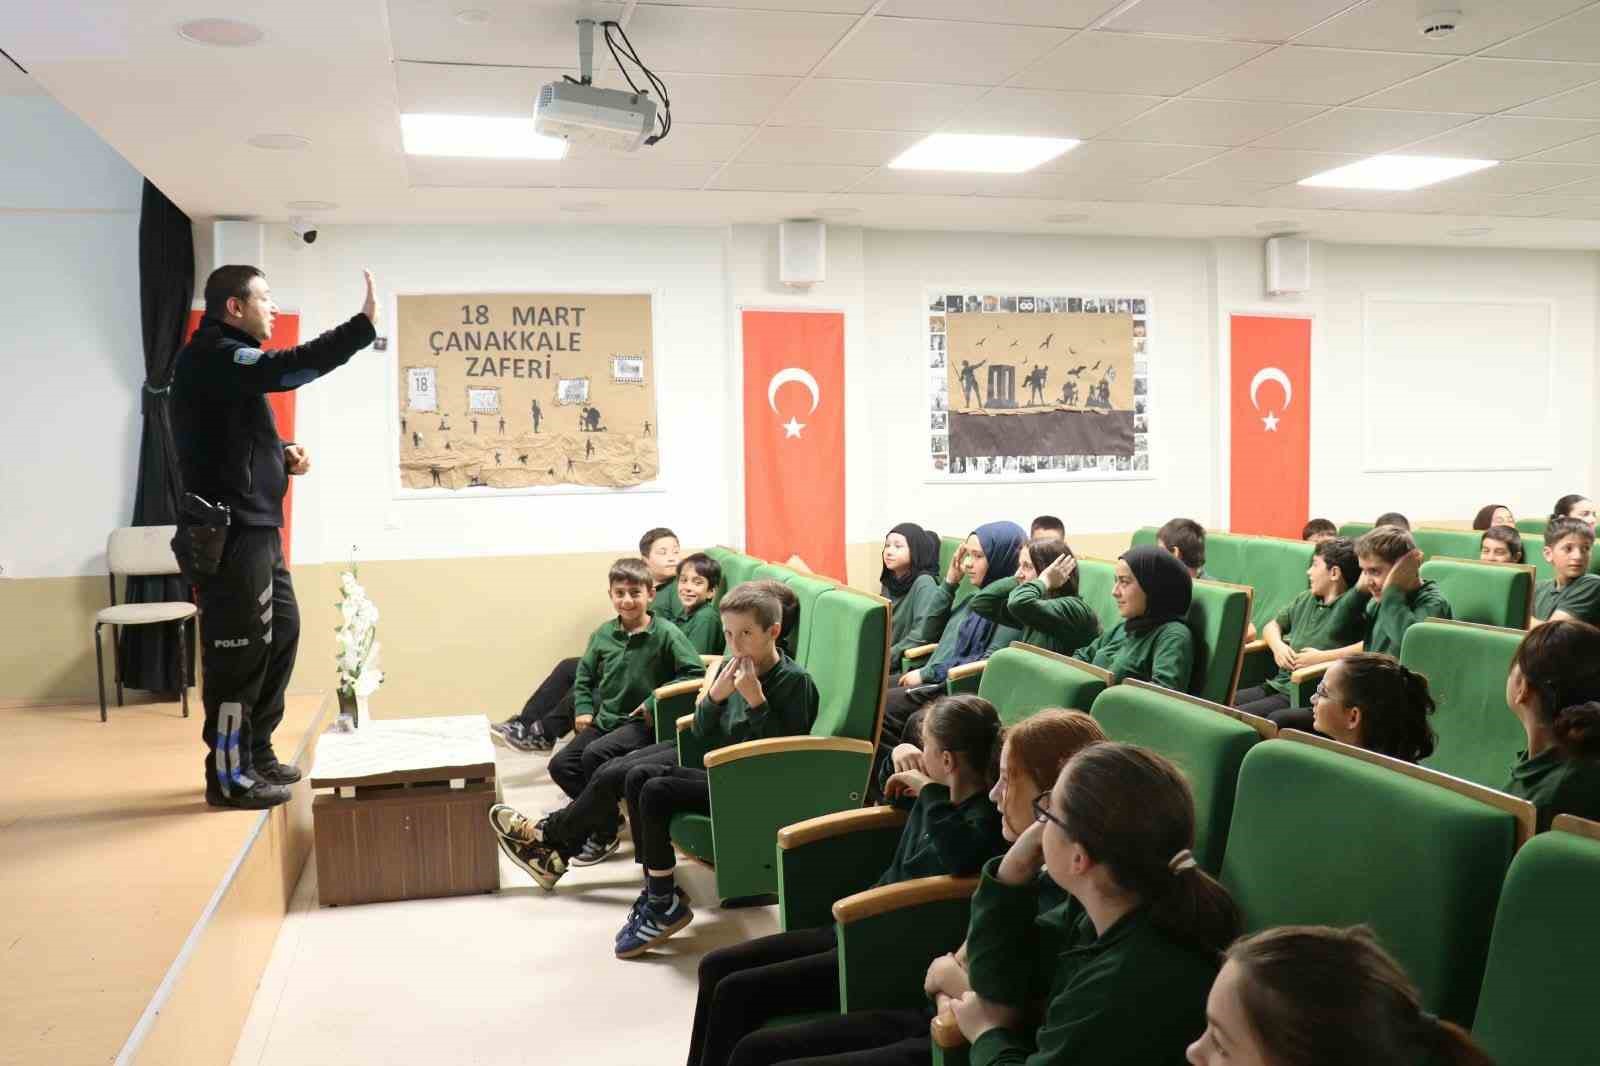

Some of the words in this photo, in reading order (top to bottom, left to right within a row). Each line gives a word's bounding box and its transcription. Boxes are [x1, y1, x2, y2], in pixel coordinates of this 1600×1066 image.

[461, 305, 489, 325] 18
[511, 306, 585, 327] MART
[429, 331, 582, 356] ÇANAKKALE
[465, 354, 551, 380] ZAFERİ
[415, 377, 428, 391] 18
